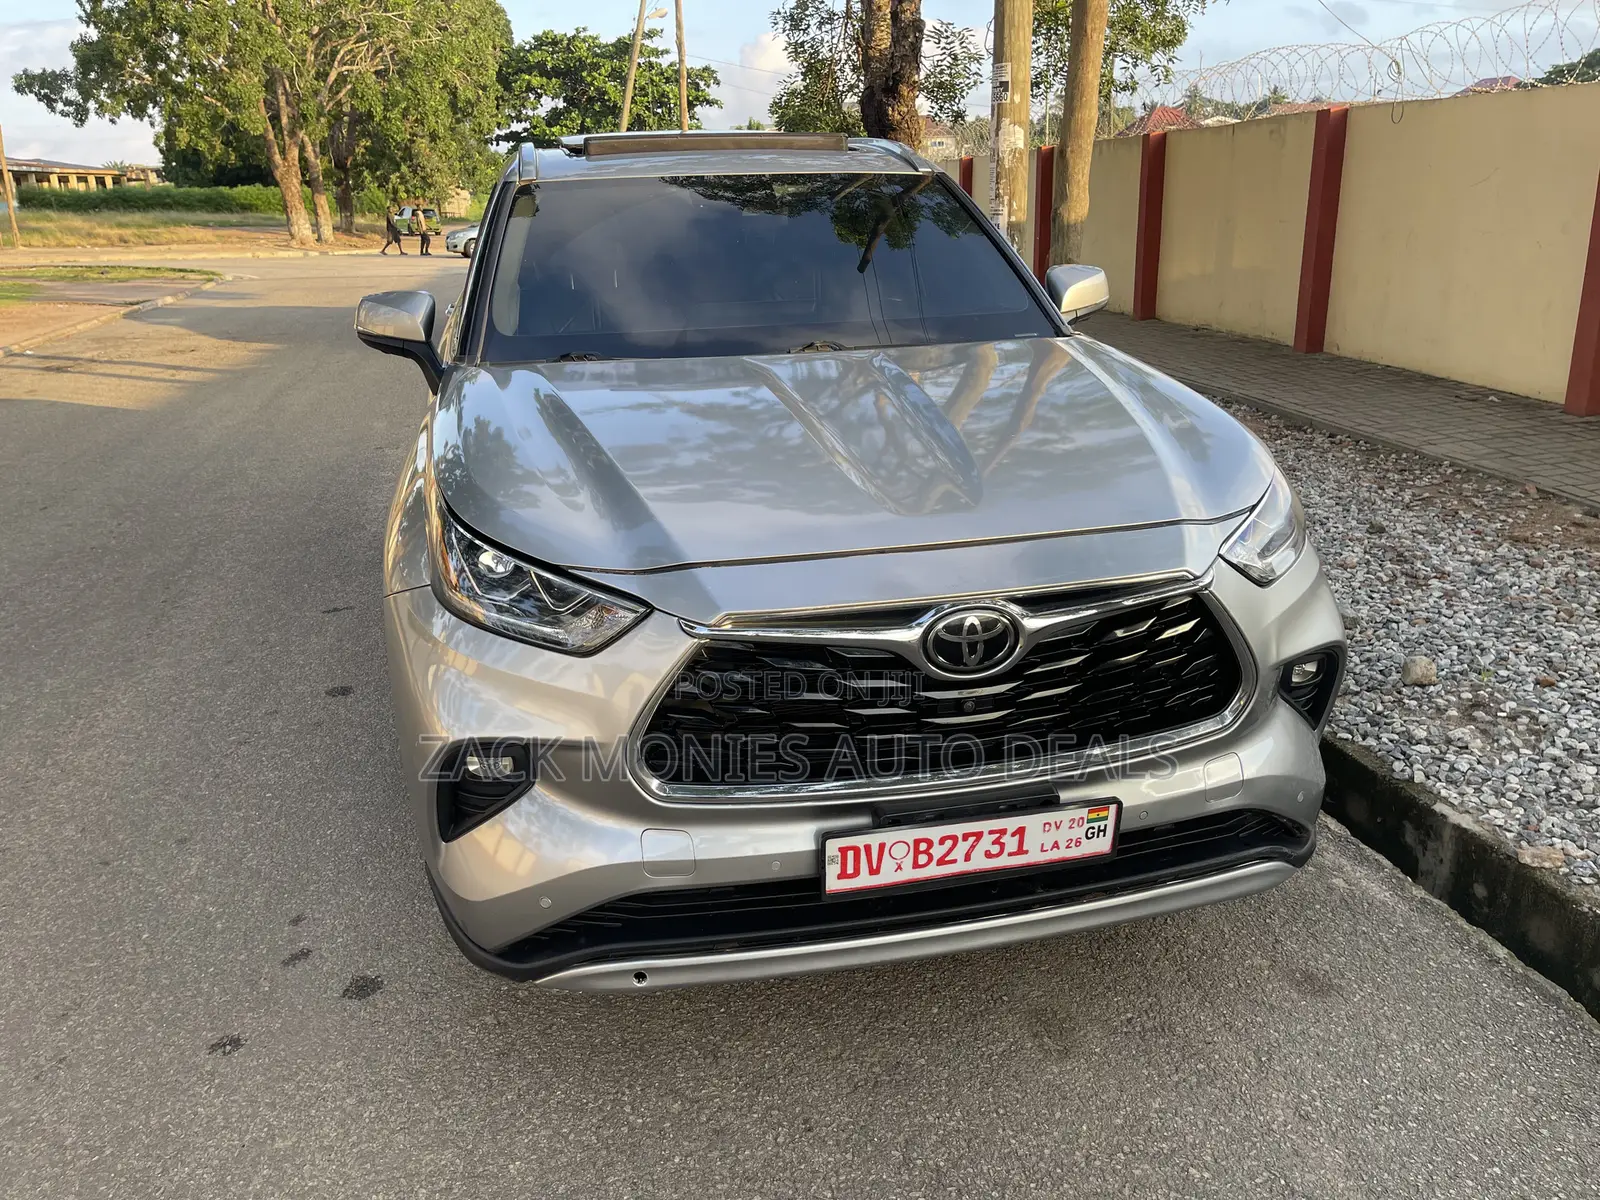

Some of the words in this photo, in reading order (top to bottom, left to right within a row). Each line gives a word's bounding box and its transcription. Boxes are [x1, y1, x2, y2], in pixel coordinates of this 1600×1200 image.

[1043, 820, 1063, 833] DV
[1068, 816, 1085, 829] 20
[1085, 824, 1107, 840] GH
[1040, 840, 1060, 853] LA
[1065, 837, 1082, 849] 26
